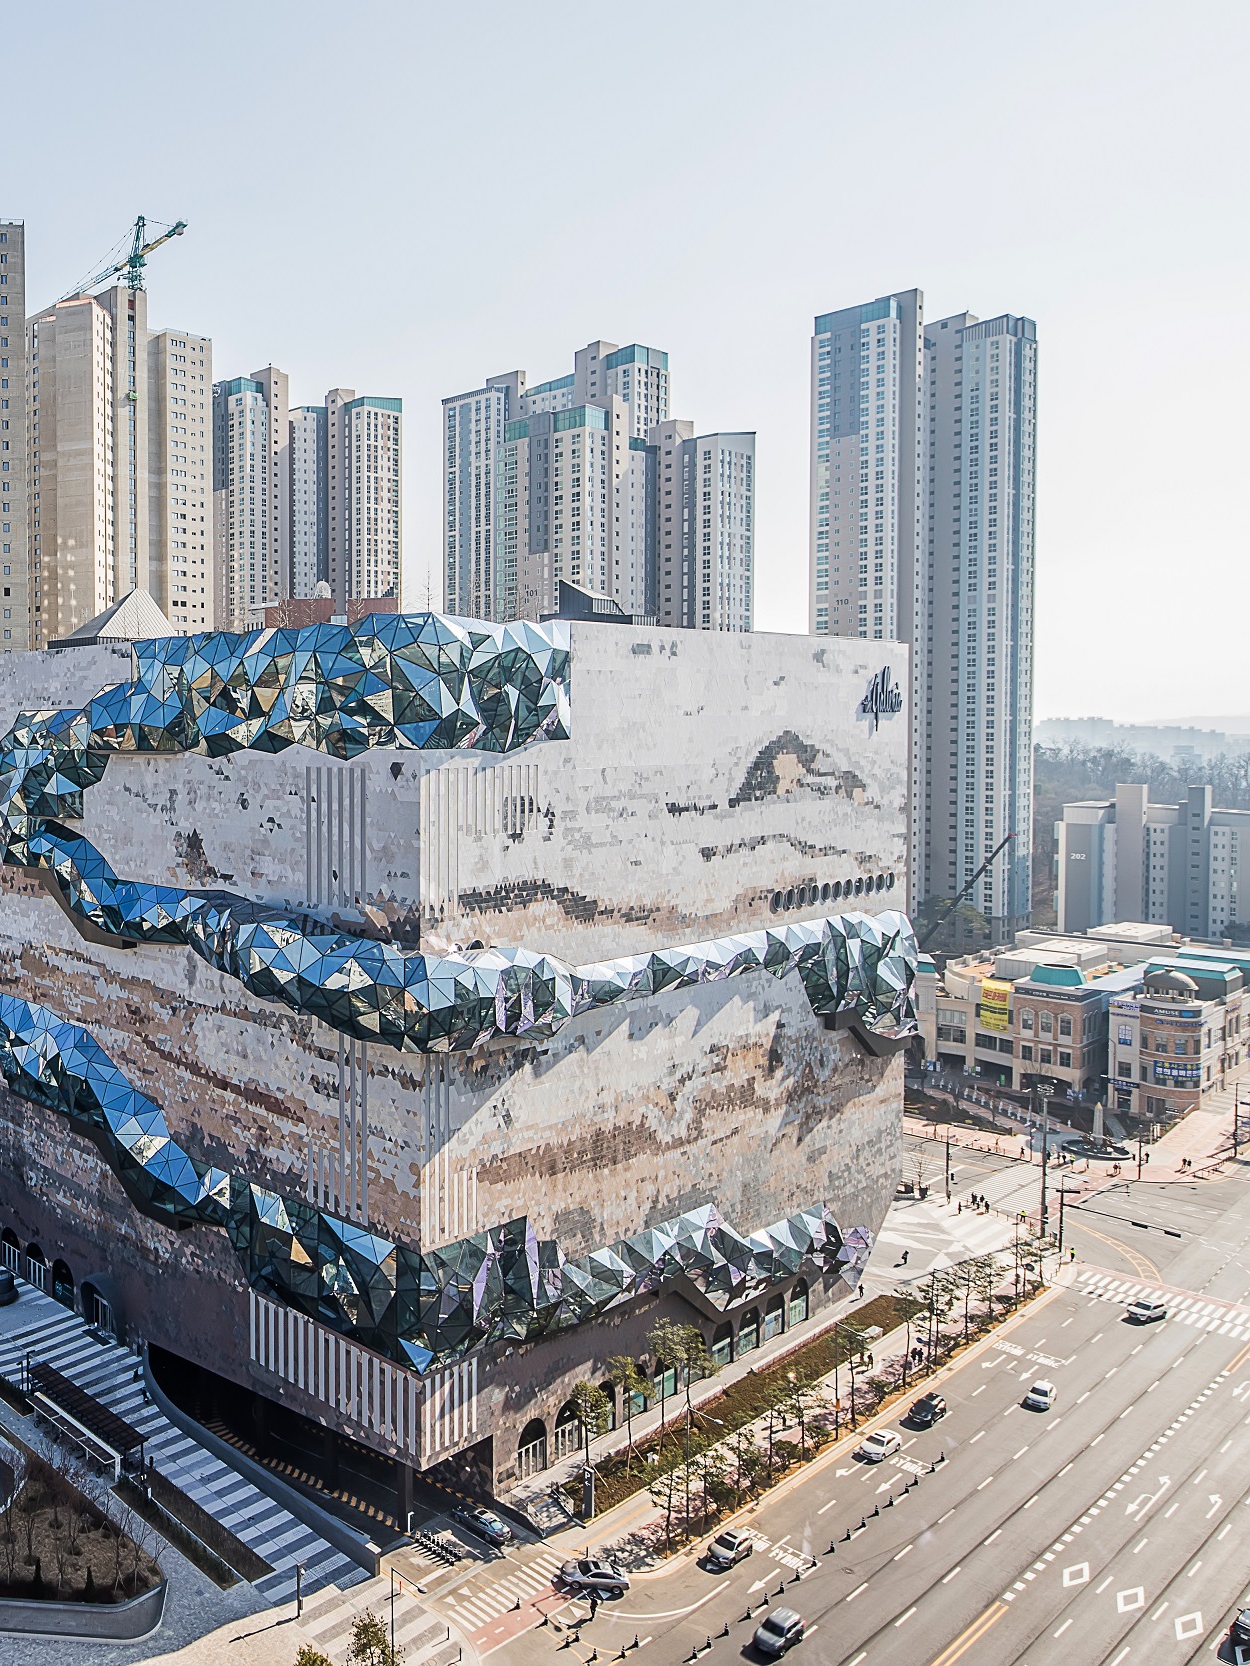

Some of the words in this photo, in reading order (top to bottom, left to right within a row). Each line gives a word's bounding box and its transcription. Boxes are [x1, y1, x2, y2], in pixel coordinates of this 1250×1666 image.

[526, 588, 538, 597] 101
[836, 598, 849, 606] 110
[1070, 852, 1086, 860] 202
[1154, 1008, 1180, 1016] AMUSE
[584, 1471, 591, 1480] P
